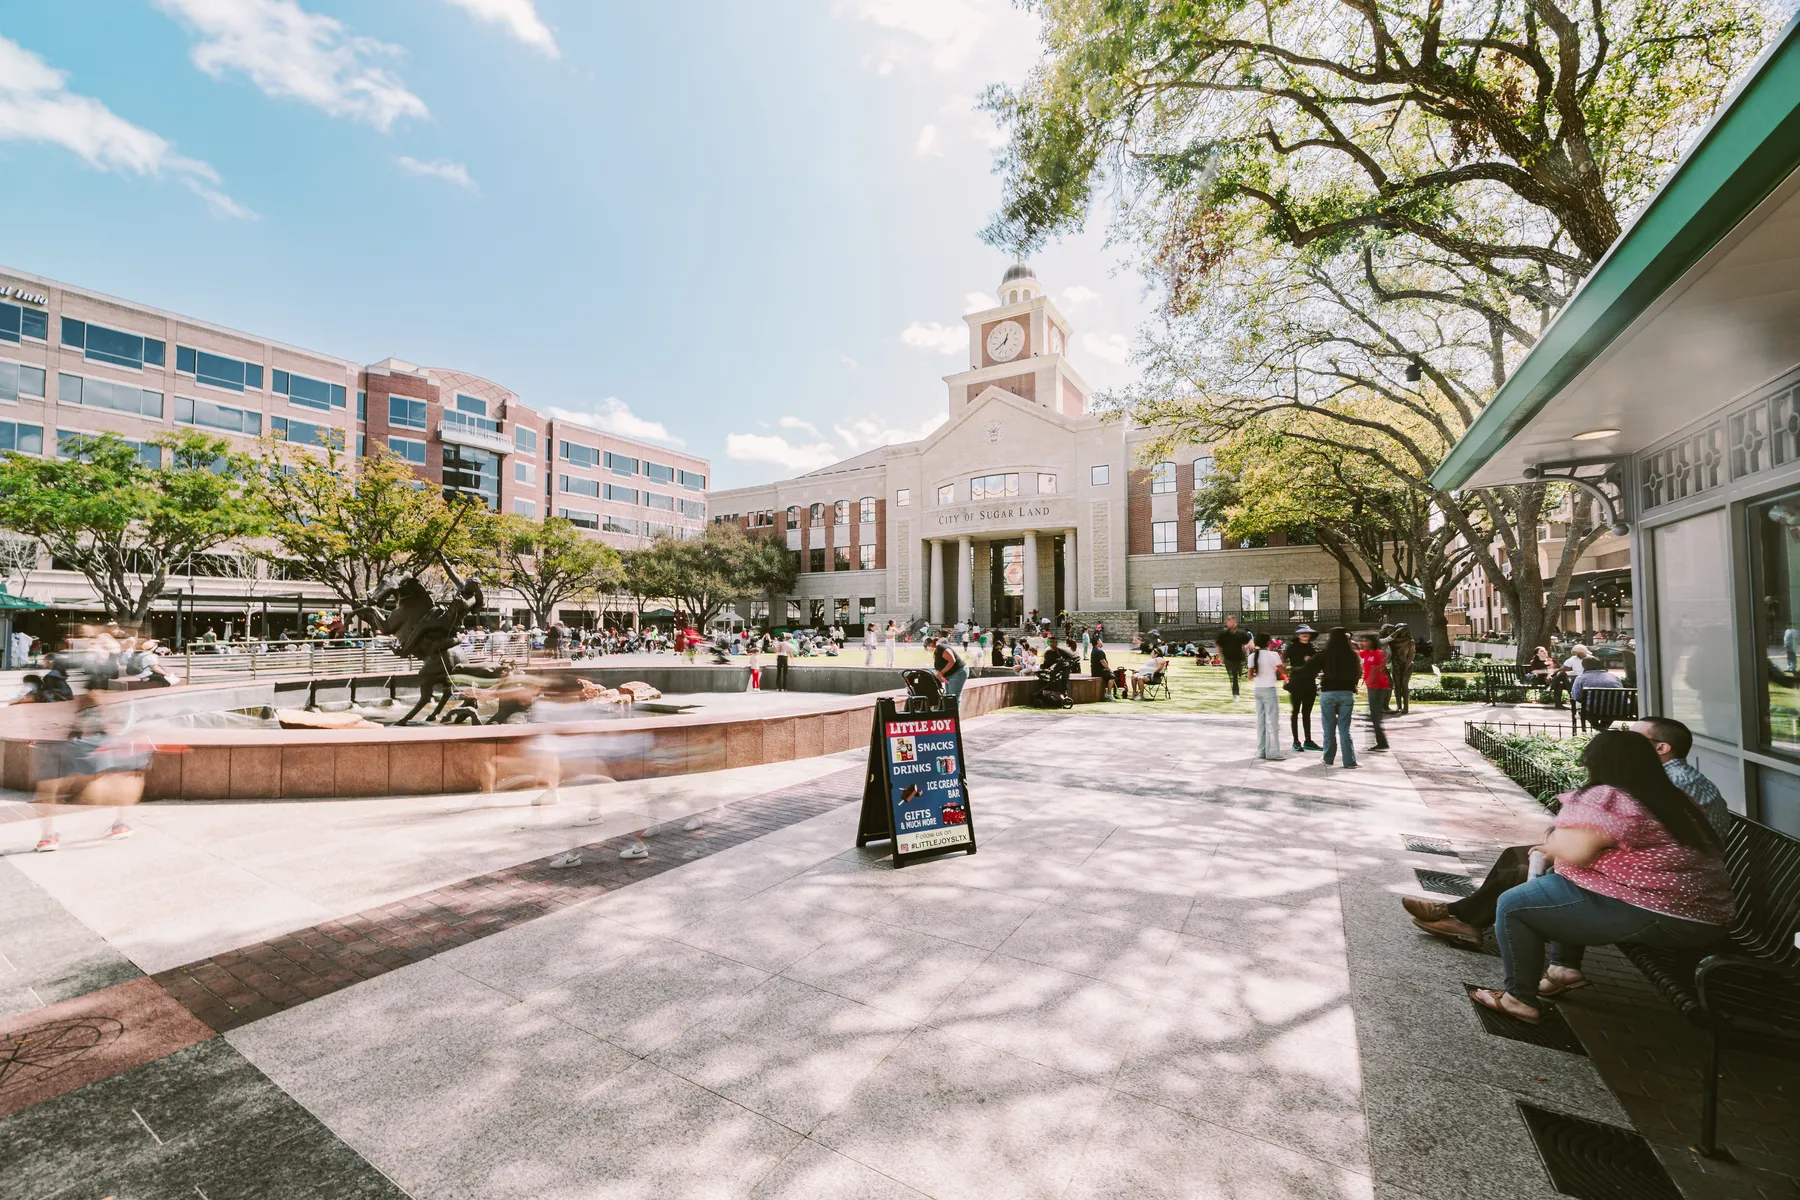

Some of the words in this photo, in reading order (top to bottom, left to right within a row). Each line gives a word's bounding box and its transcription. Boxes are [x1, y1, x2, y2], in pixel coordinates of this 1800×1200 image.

[15, 289, 48, 305] Info
[939, 514, 959, 525] CITY
[964, 513, 974, 522] OF
[980, 509, 1014, 520] SUGAR
[1019, 507, 1050, 517] LAND
[889, 721, 929, 734] LITTLE
[930, 719, 951, 731] JOY
[917, 741, 954, 752] SNACKS
[893, 763, 932, 775] DRINKS
[926, 781, 938, 790] ICE
[938, 778, 959, 789] CREAM
[947, 789, 960, 799] BAR
[904, 808, 931, 821] GIFTS
[900, 822, 905, 830] &
[906, 819, 921, 829] MUCH
[922, 817, 937, 827] MORE
[911, 834, 968, 849] #LITTLEJOYSLTX
[915, 832, 934, 840] Follow
[936, 830, 943, 838] us
